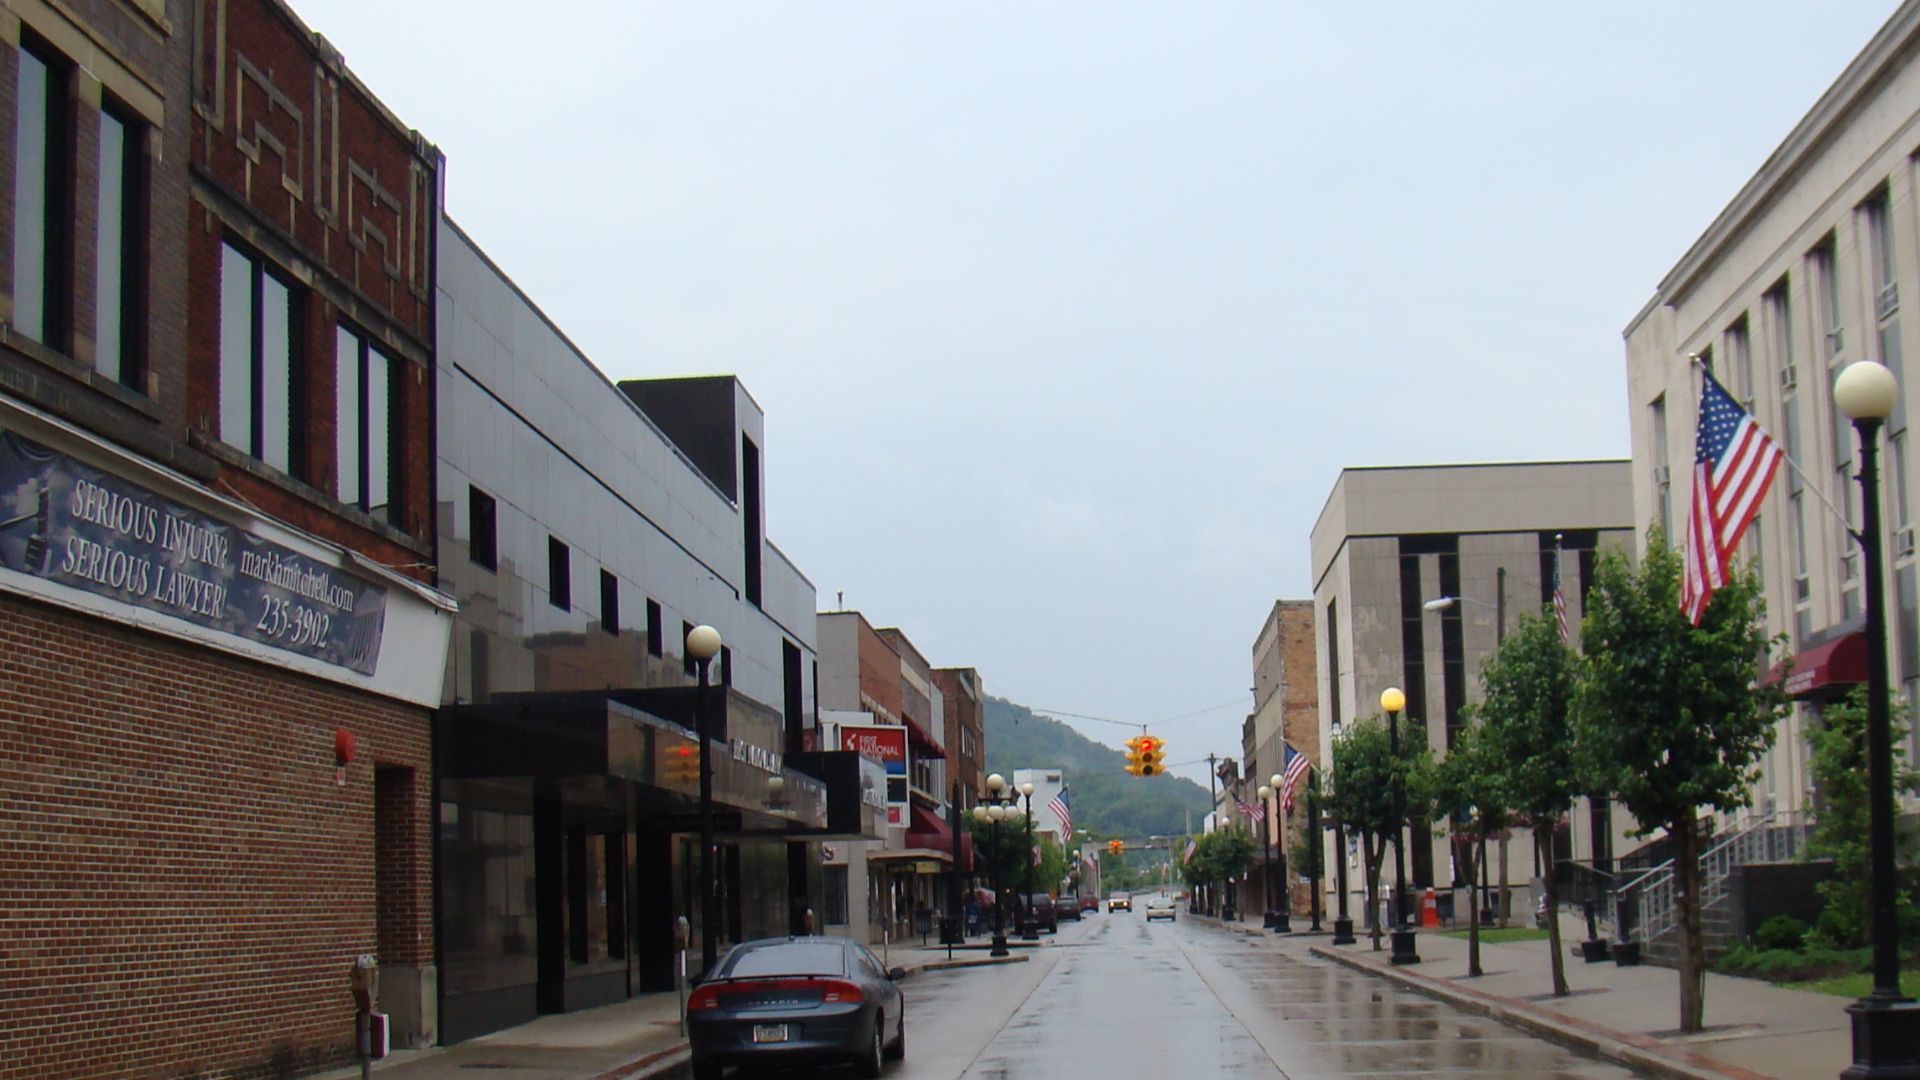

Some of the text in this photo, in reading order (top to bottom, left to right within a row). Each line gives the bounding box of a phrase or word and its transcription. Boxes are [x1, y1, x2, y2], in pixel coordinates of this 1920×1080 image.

[72, 479, 228, 569] SERIOUS INJURY?
[62, 535, 227, 619] SERIOUS LAWYER!
[240, 550, 354, 612] markhmitchell.com
[257, 594, 330, 649] 235-3902
[860, 736, 878, 745] FIRST
[860, 743, 898, 755] NATIONAL
